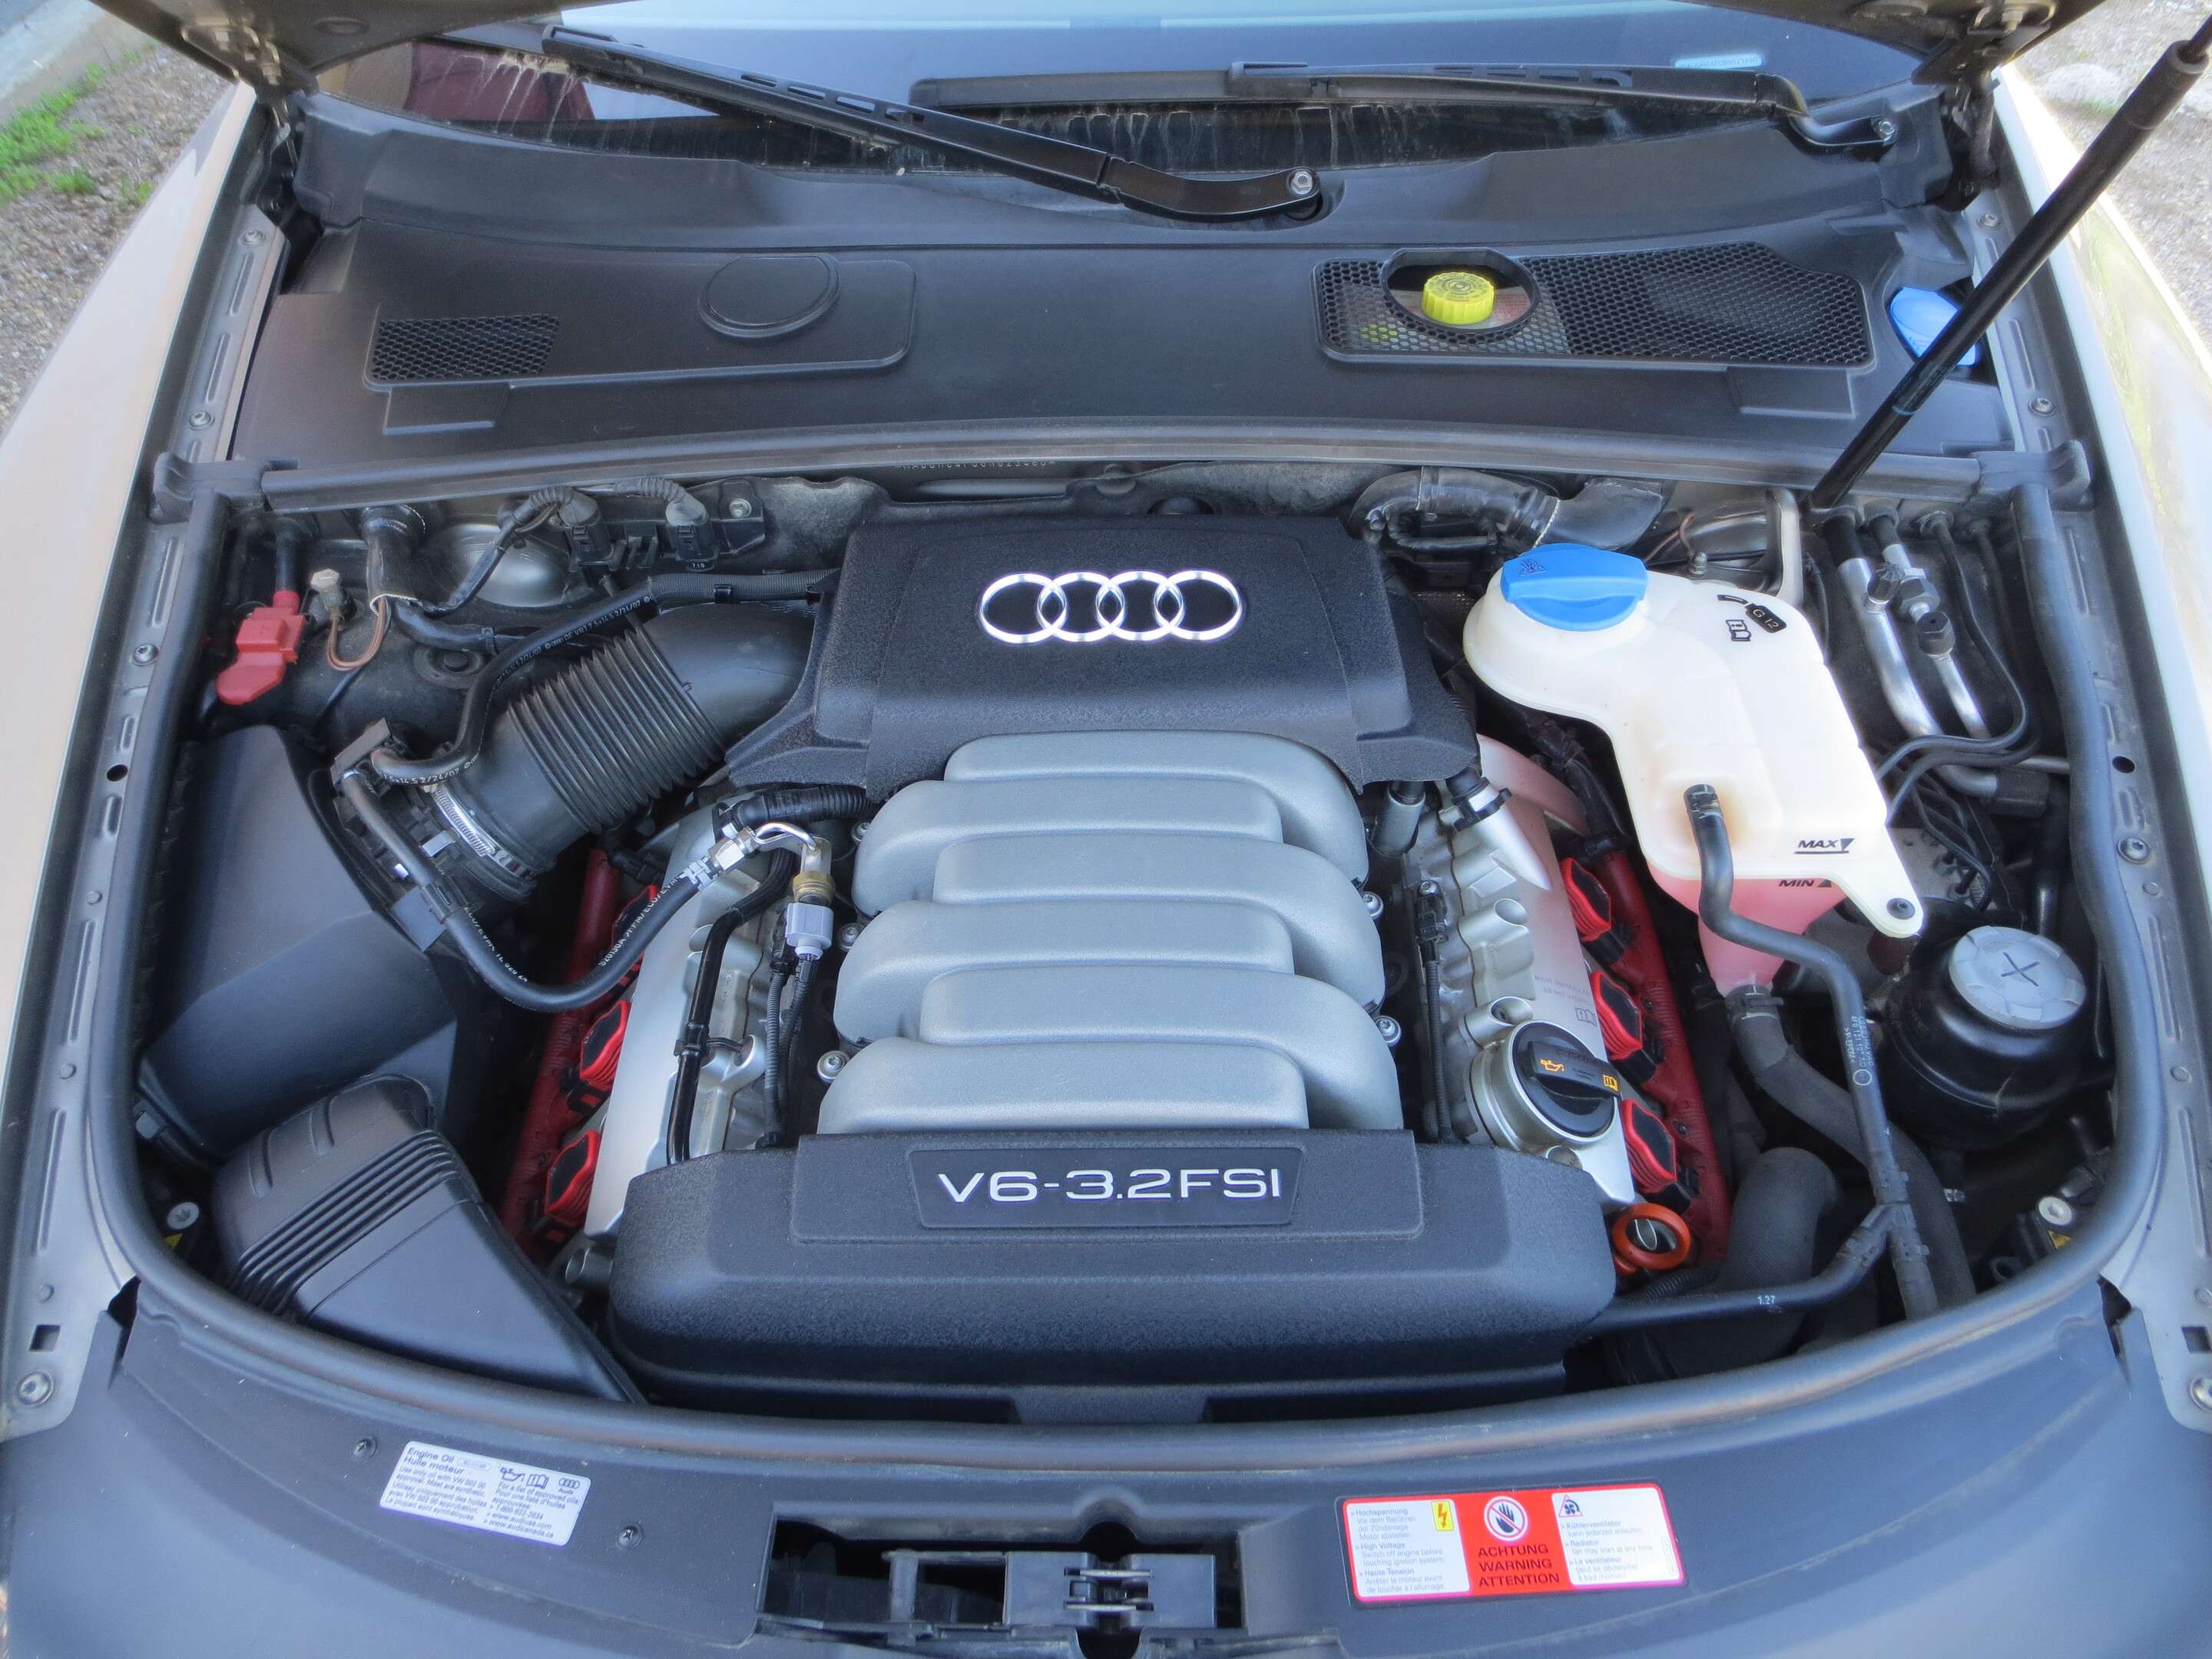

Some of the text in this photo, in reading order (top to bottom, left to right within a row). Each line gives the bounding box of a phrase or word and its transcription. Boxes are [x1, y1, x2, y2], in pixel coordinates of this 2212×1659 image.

[1753, 609, 1779, 628] G 12
[1797, 839, 1839, 849] MAX
[1778, 879, 1815, 887] MIN
[937, 1168, 1281, 1203] V6-3.2FSI
[406, 1447, 455, 1463] Engine Oil
[402, 1455, 428, 1467] Huile
[428, 1462, 465, 1475] moteur
[1476, 1543, 1548, 1557] ACHTUNG
[1478, 1558, 1552, 1571] WARNING
[1477, 1572, 1560, 1587] ATTENTION
